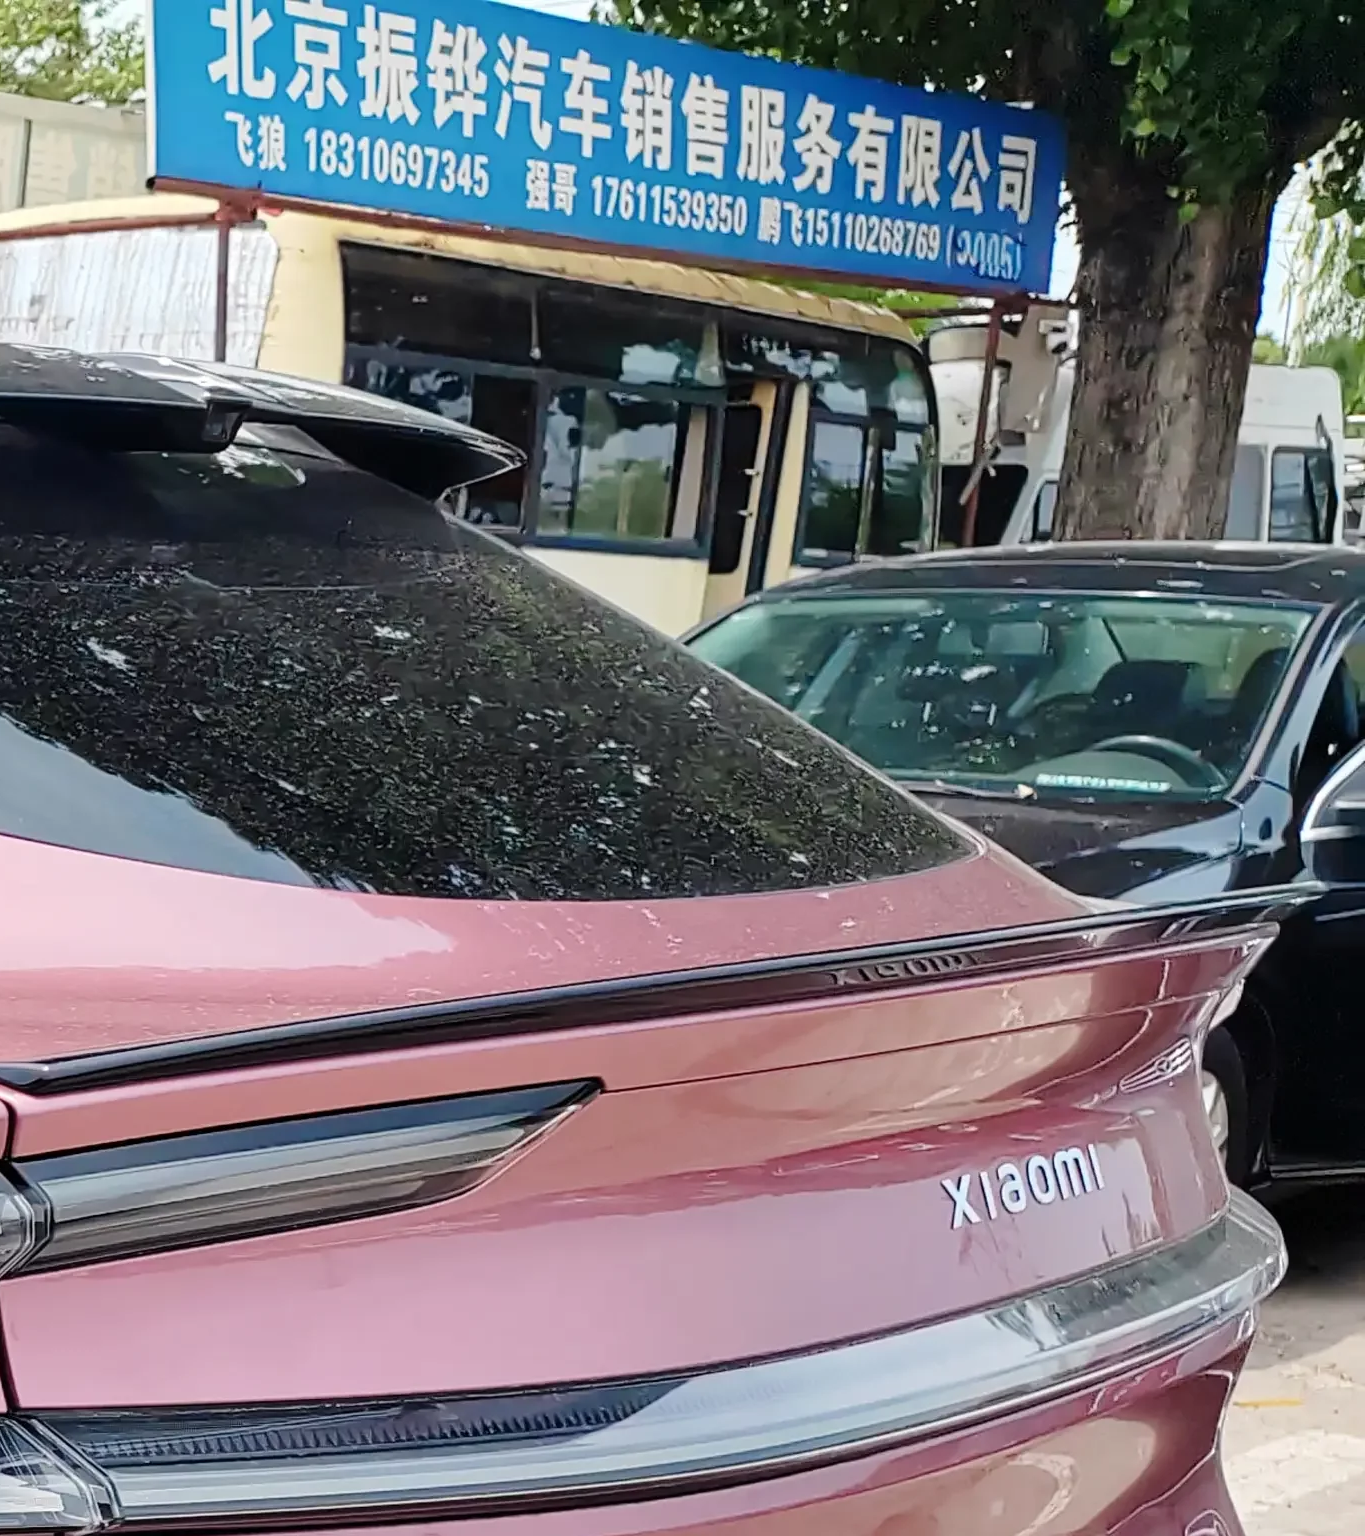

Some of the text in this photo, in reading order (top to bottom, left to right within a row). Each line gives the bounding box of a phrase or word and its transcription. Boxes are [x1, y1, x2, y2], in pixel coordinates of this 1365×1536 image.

[207, 0, 1037, 224] 北京振铧汽车销售服务有限公司
[224, 111, 287, 172] 飞狼
[303, 127, 490, 198] 18310697345
[525, 158, 578, 216] 强哥
[592, 175, 748, 237] 17611539350
